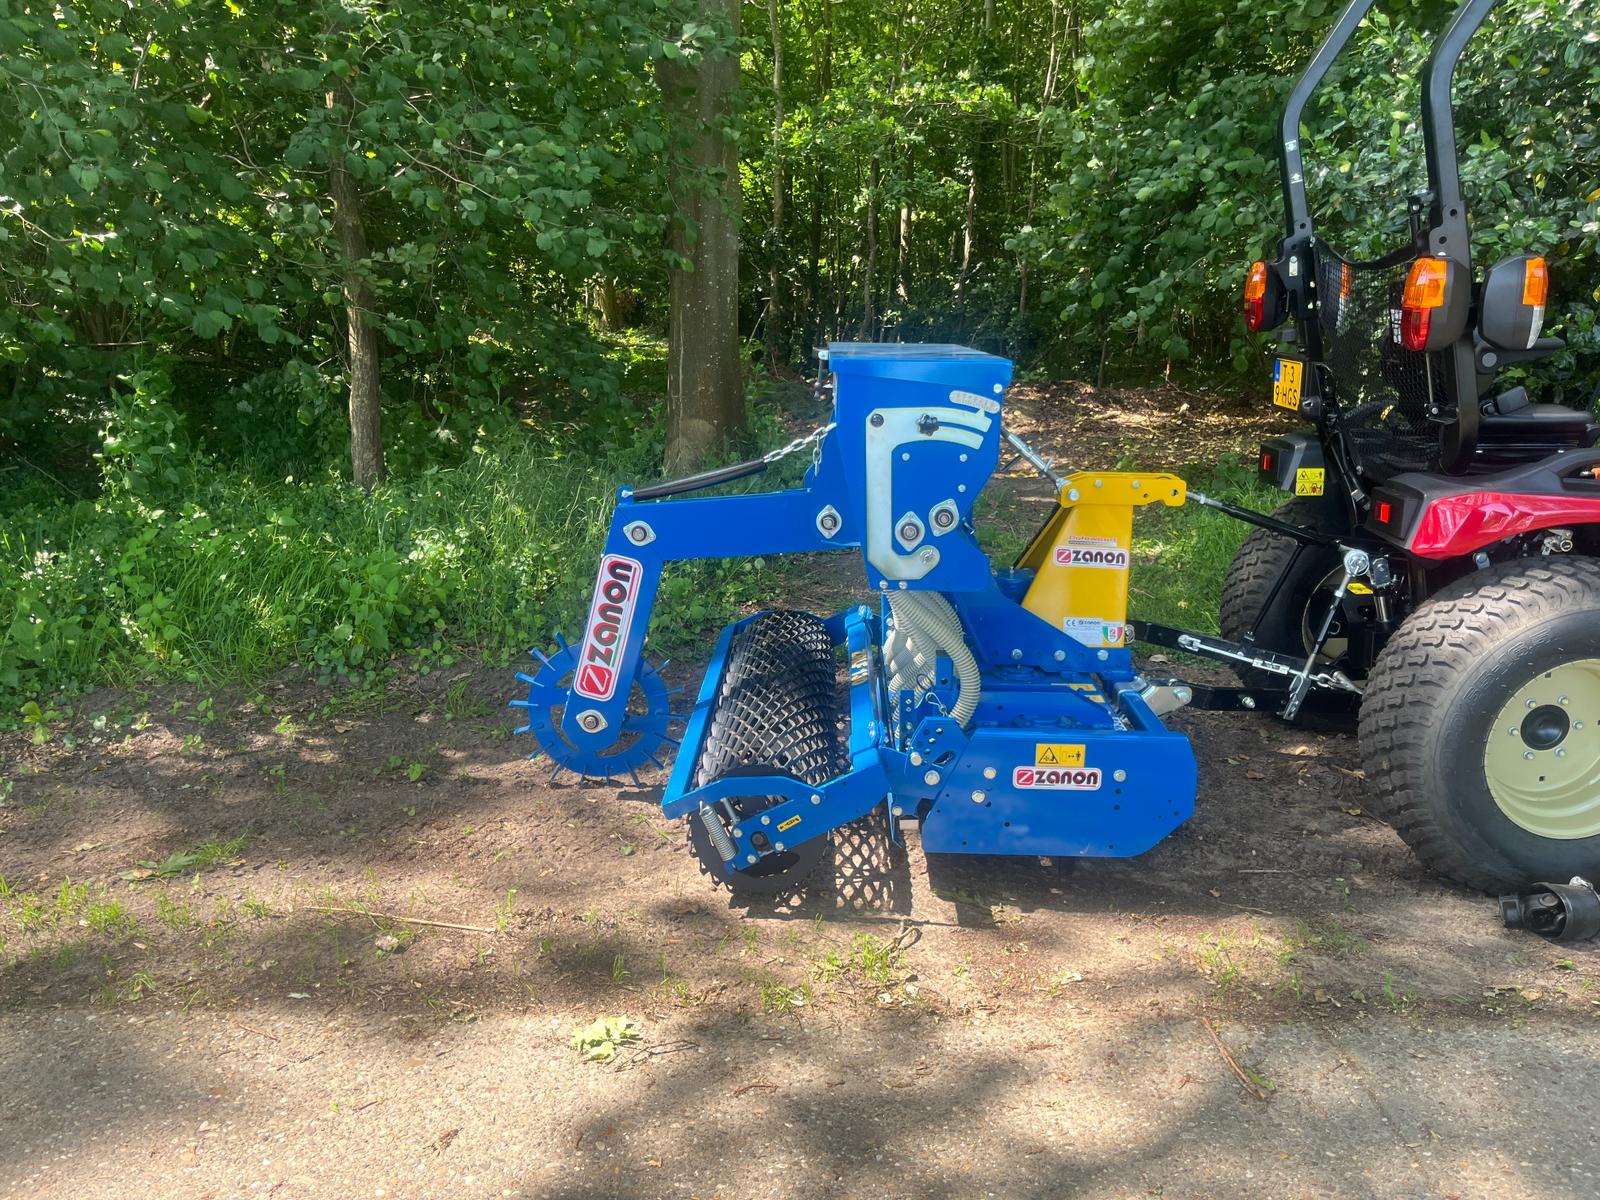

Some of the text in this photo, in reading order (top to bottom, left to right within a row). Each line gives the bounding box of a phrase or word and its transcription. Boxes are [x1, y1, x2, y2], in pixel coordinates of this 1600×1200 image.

[1072, 549, 1126, 565] zanon
[587, 560, 633, 667] zanon
[1034, 770, 1099, 785] zanon
